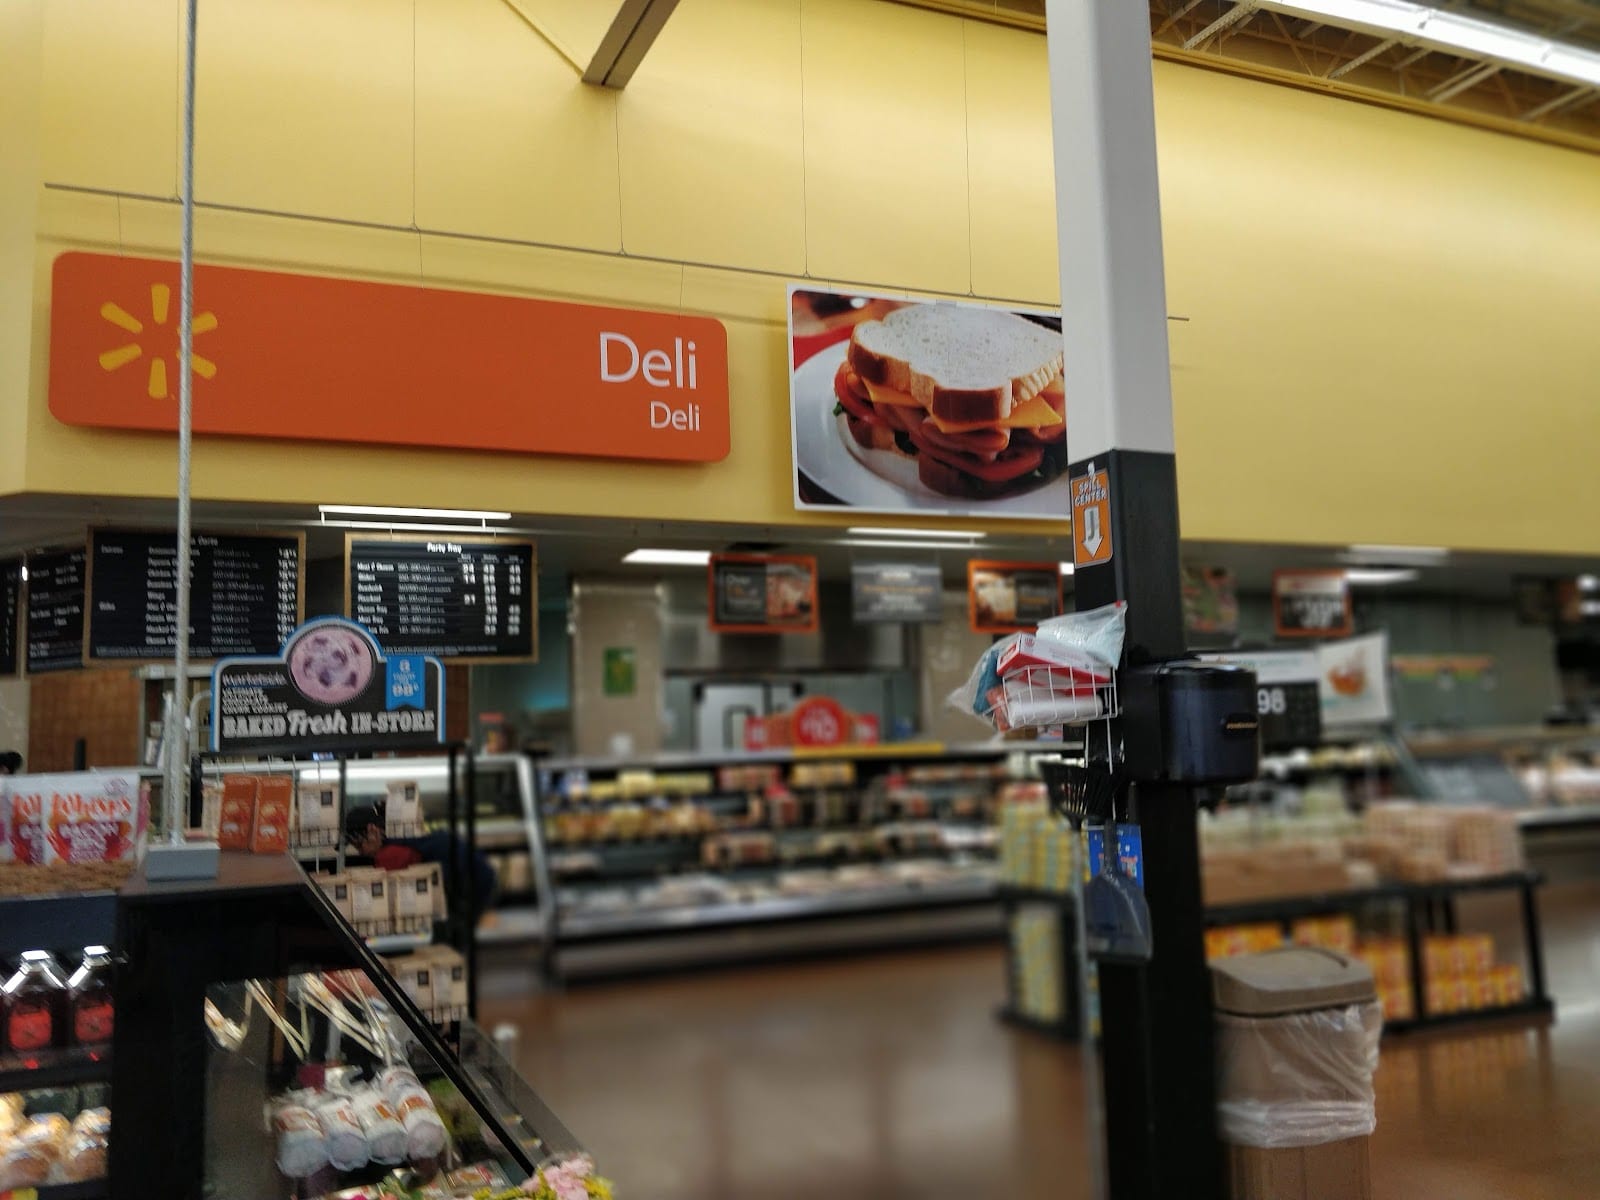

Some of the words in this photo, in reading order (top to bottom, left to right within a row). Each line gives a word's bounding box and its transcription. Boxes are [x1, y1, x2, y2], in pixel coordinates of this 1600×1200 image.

[599, 331, 697, 390] Deli
[650, 401, 700, 432] Deli
[427, 543, 446, 554] Party
[222, 715, 287, 738] BAKED
[287, 709, 348, 737] Fresh
[350, 710, 435, 735] IN-STORE
